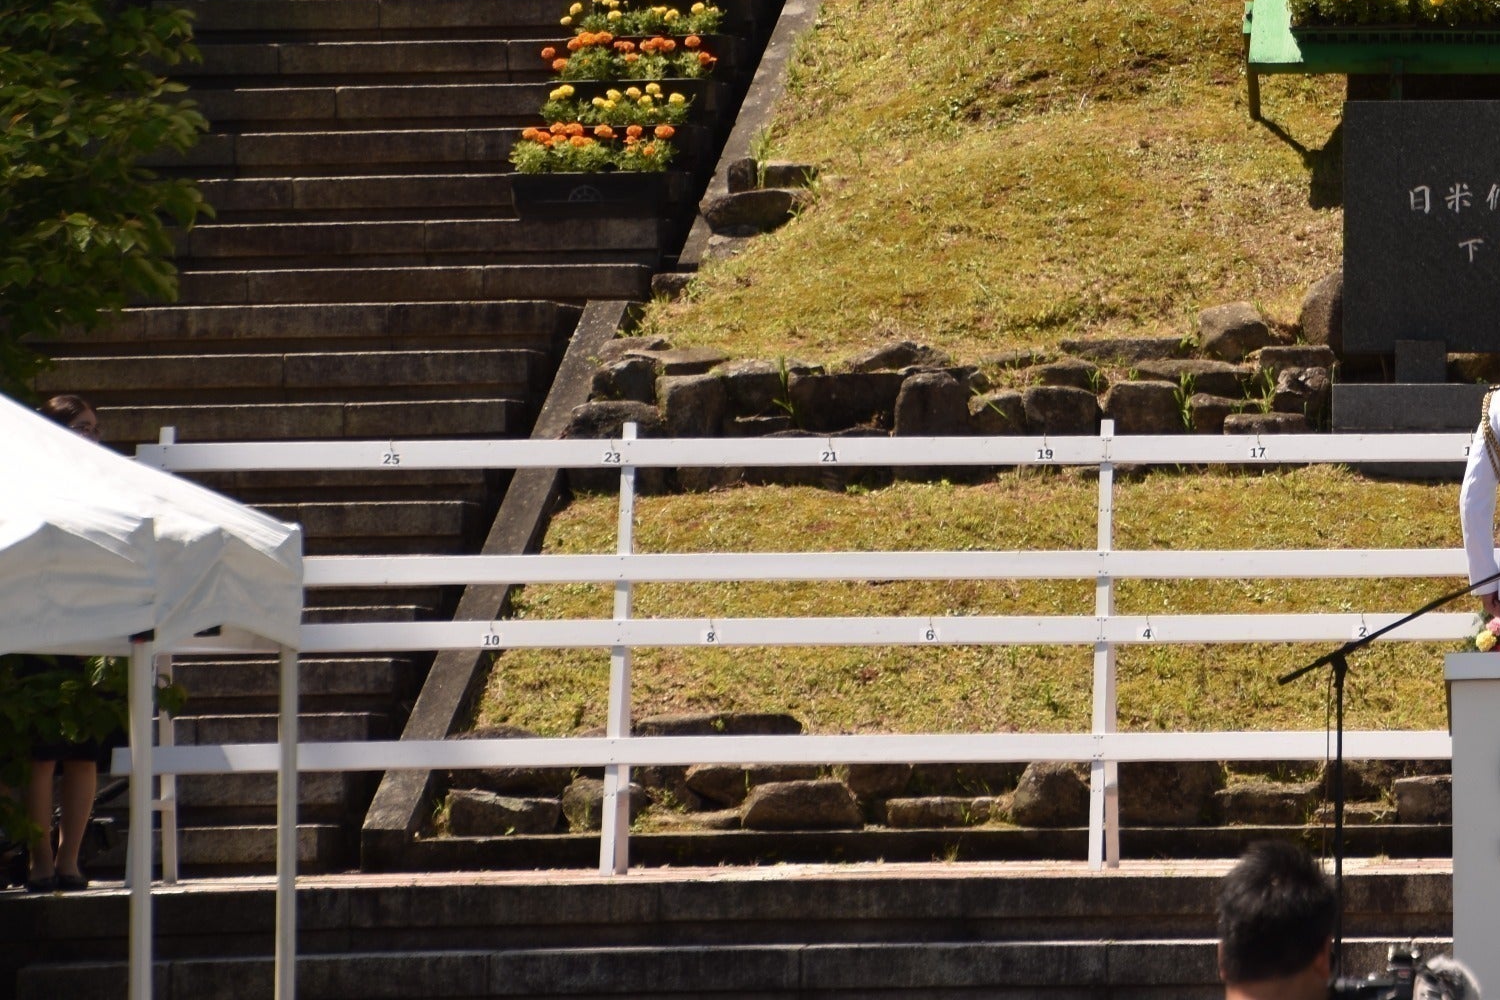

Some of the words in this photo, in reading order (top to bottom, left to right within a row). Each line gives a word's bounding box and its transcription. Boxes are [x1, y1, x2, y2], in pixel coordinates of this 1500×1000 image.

[604, 452, 621, 463] 23
[822, 451, 838, 462] 21
[1037, 448, 1054, 460] 19
[1251, 446, 1266, 458] 17
[383, 453, 400, 465] 25
[706, 631, 716, 642] 8
[925, 629, 935, 641] 6
[1142, 628, 1151, 640] 4
[1357, 627, 1368, 639] 2
[484, 635, 500, 646] 10
